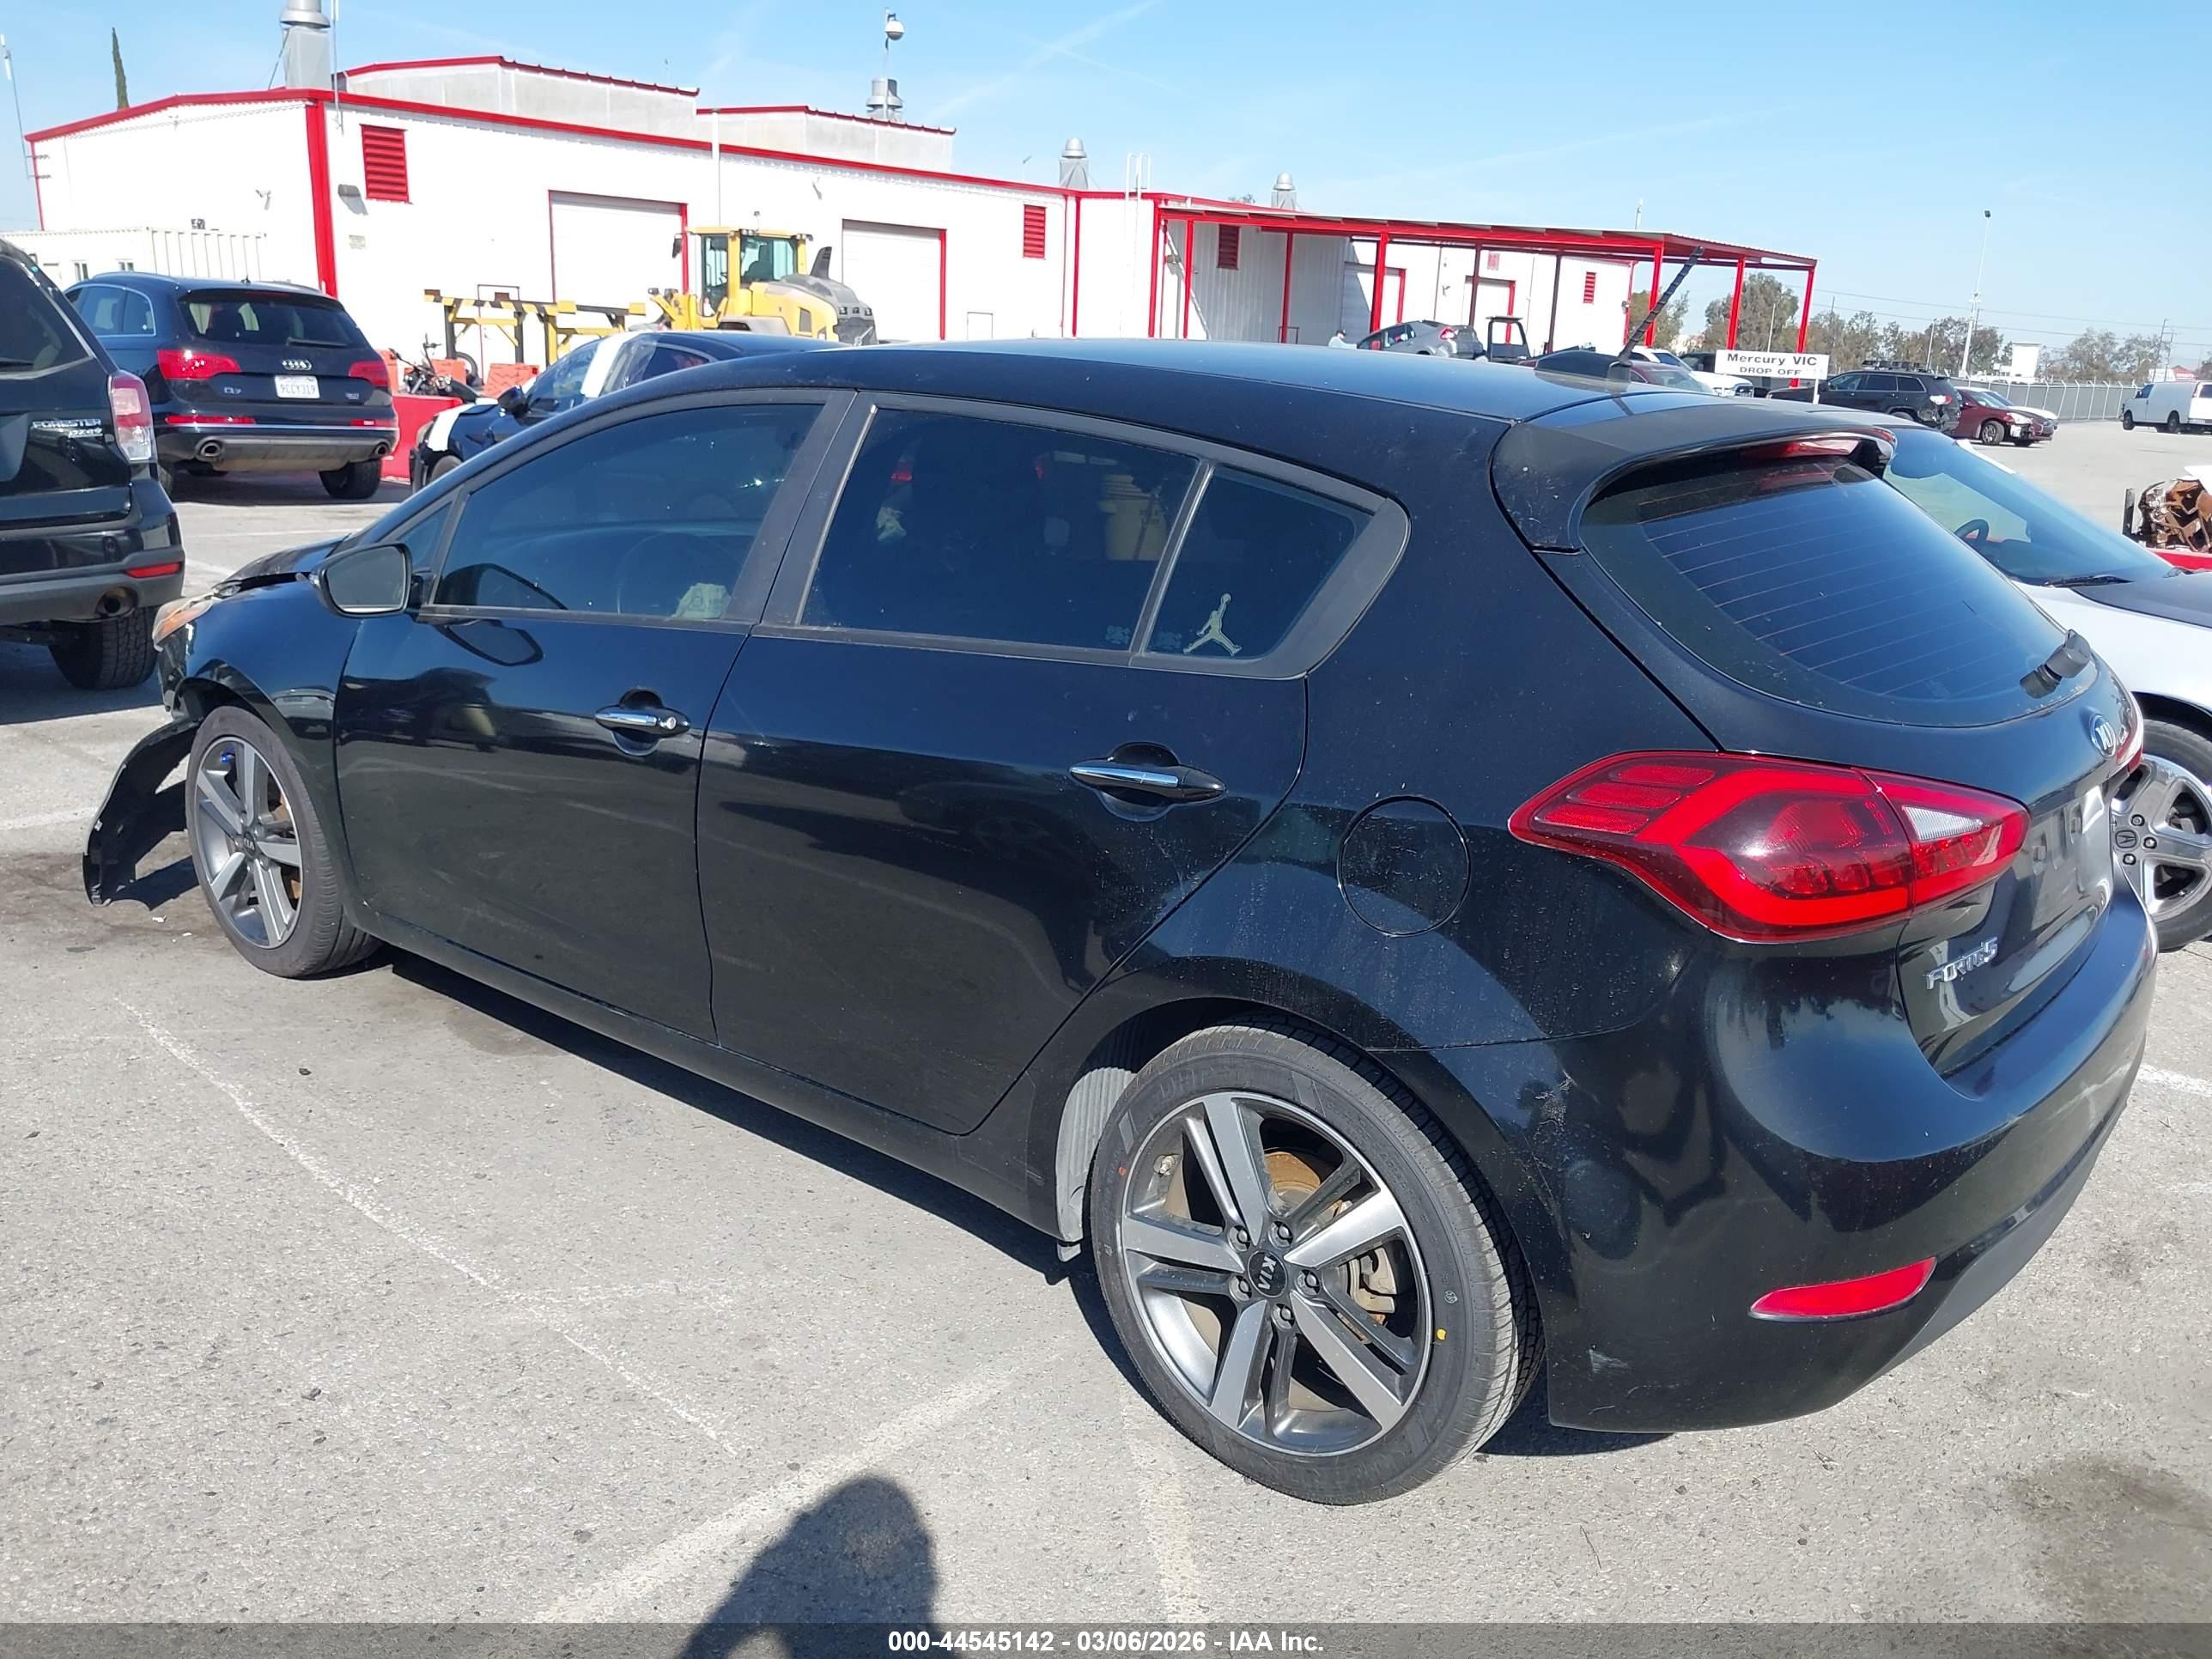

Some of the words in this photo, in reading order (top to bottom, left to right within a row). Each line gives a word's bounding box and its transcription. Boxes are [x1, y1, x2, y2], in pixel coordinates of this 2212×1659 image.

[1727, 353, 1786, 366] Mercury
[1793, 356, 1818, 366] VIC
[33, 418, 101, 428] FORESTER
[1257, 1255, 1277, 1290] KIA
